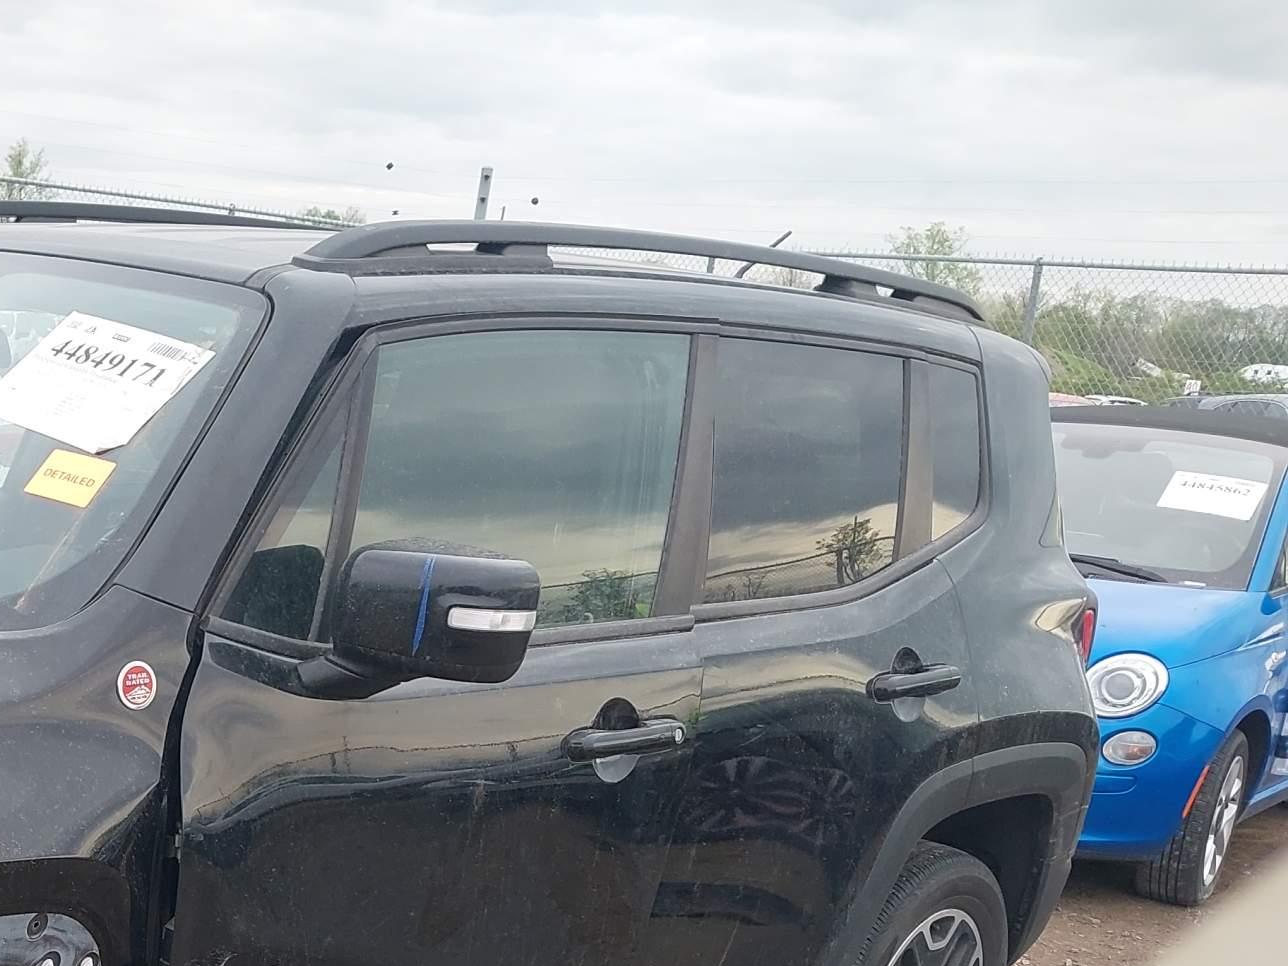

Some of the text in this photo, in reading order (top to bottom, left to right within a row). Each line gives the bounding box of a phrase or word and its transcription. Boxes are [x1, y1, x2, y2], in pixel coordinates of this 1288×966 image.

[50, 339, 167, 388] 44849171
[43, 468, 96, 488] DETAILED
[125, 678, 151, 687] RATED
